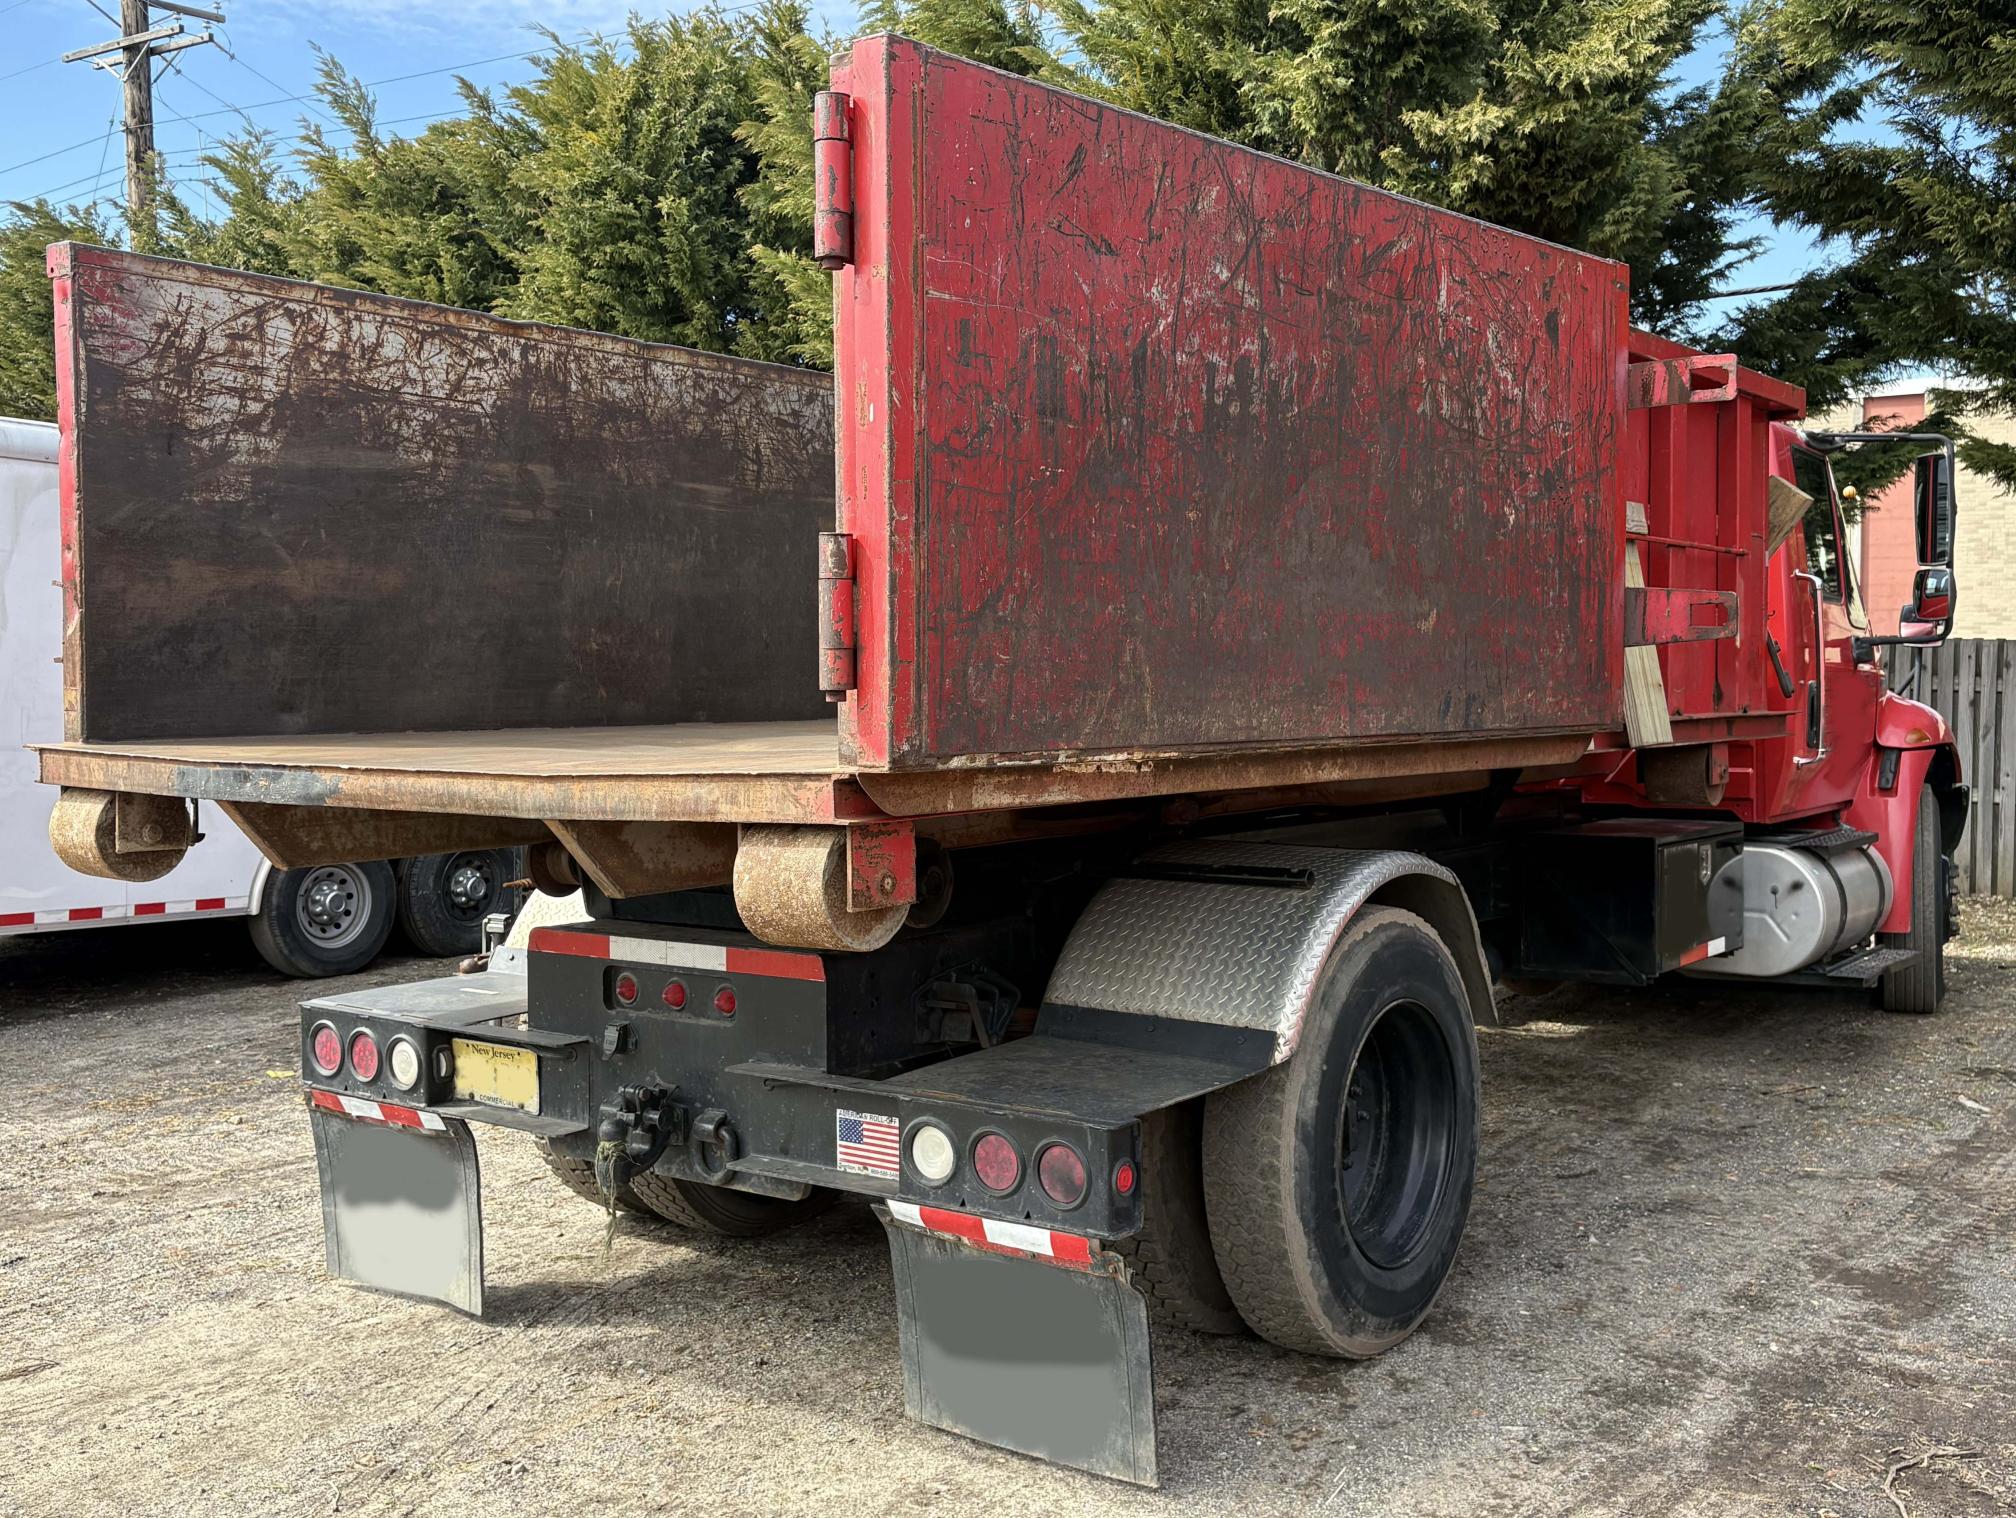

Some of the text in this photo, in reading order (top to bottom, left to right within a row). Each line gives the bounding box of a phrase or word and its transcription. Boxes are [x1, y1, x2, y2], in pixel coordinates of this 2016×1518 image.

[471, 1044, 516, 1062] New Jersey
[479, 1094, 515, 1107] COMMERCIAL
